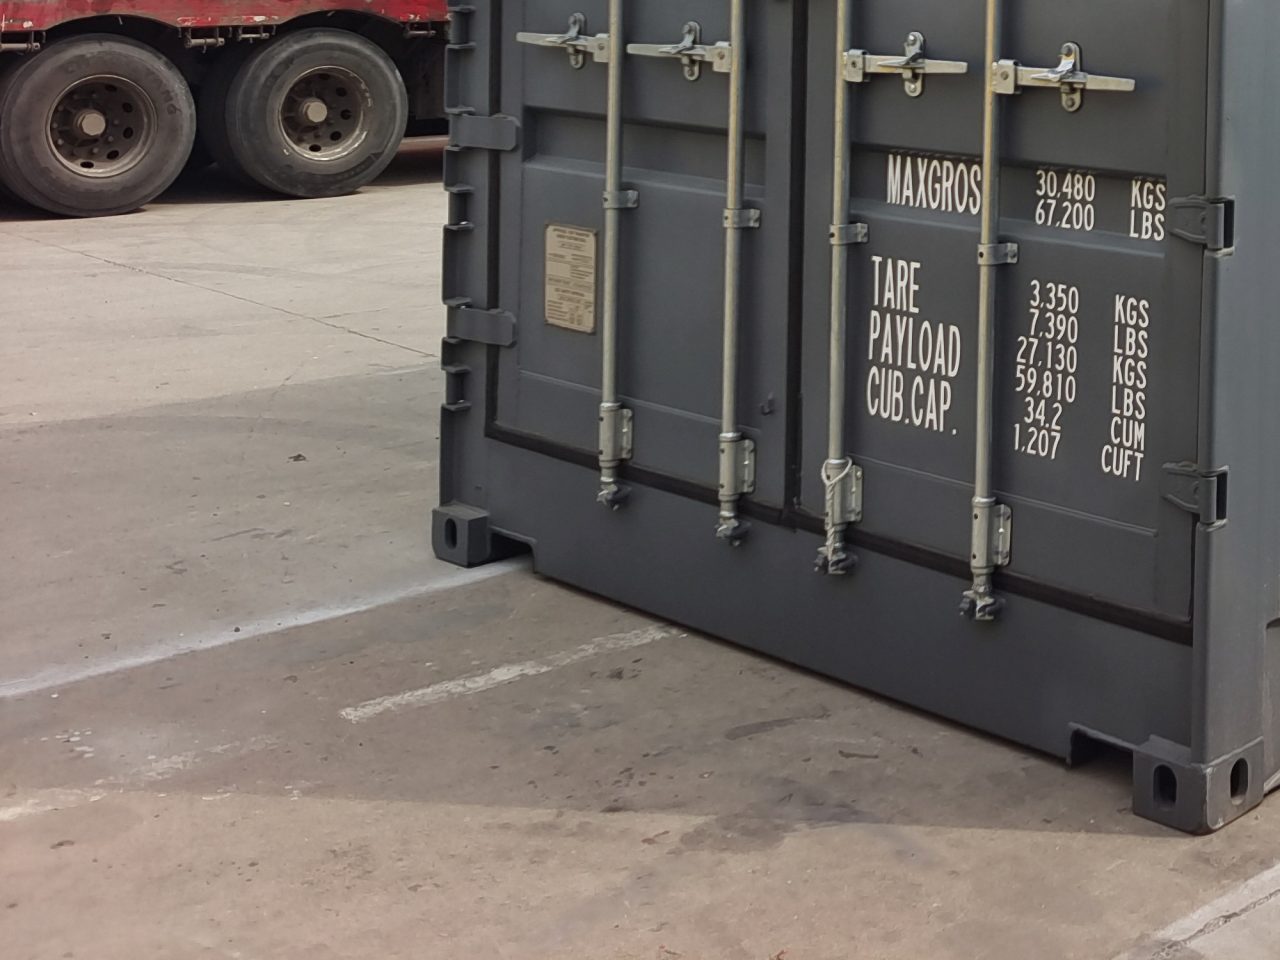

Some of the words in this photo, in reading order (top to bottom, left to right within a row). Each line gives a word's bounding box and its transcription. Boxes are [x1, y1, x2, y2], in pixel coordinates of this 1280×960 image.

[1036, 170, 1096, 202] 30,480
[1130, 180, 1166, 211] KGS
[1035, 198, 1095, 232] 67,200
[1128, 209, 1165, 242] LBS
[871, 255, 921, 314] TARE
[1029, 279, 1079, 314] 3,350
[1114, 294, 1150, 328] KGS
[868, 309, 961, 378] PAYLOAD
[1016, 335, 1078, 374] 27,130
[1112, 354, 1147, 389] KGS
[1029, 308, 1079, 344] 7,390
[1113, 324, 1148, 359] LBS
[1015, 364, 1076, 403] 59,810
[1111, 384, 1146, 420] LBS
[1023, 396, 1063, 431] 34.2
[1110, 416, 1145, 451] CUM
[1013, 423, 1061, 460] 1,207
[1101, 444, 1144, 481] CUFT
